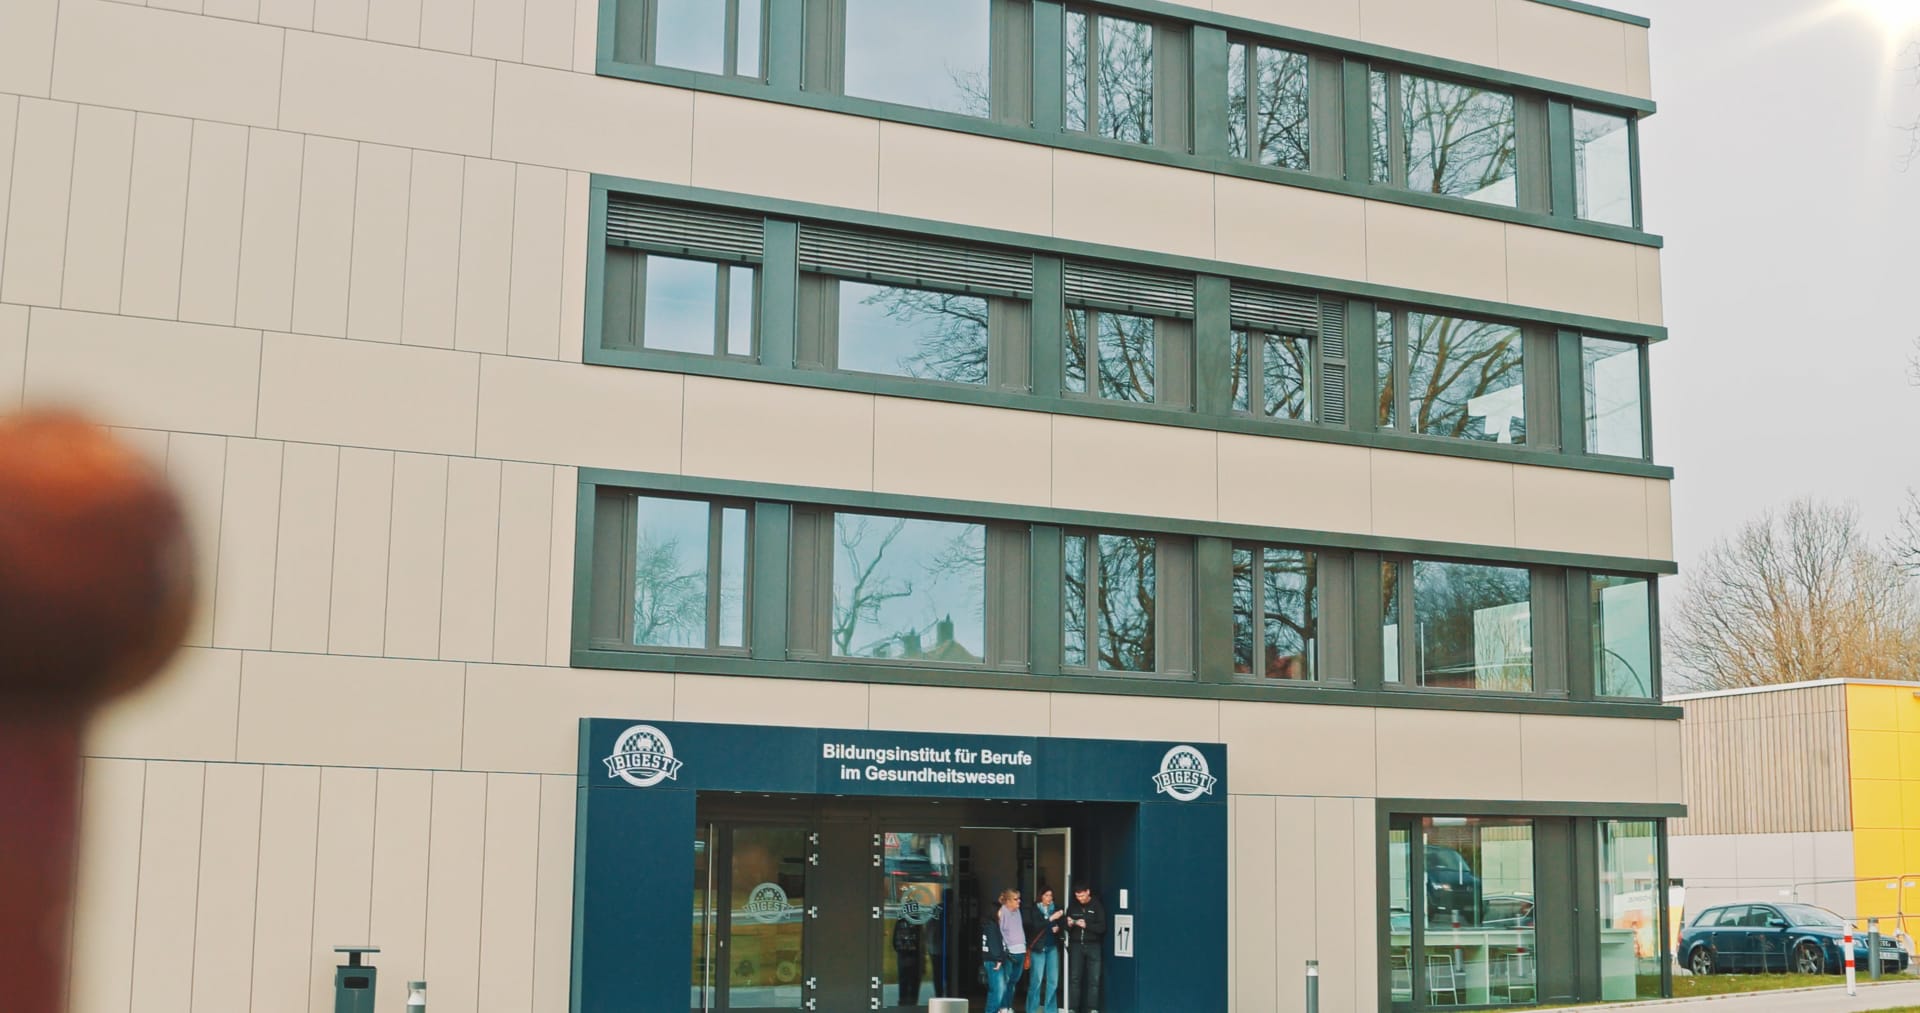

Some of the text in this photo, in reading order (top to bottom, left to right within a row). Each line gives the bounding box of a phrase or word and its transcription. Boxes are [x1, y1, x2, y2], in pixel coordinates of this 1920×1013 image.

[613, 753, 671, 771] BIGEST
[822, 743, 1032, 766] Bildungsinstitut für Berufe
[840, 764, 1015, 784] im Gesundheitswesen
[1161, 771, 1208, 787] BIGEST
[749, 902, 787, 912] BIGEST
[1117, 926, 1130, 951] 17
